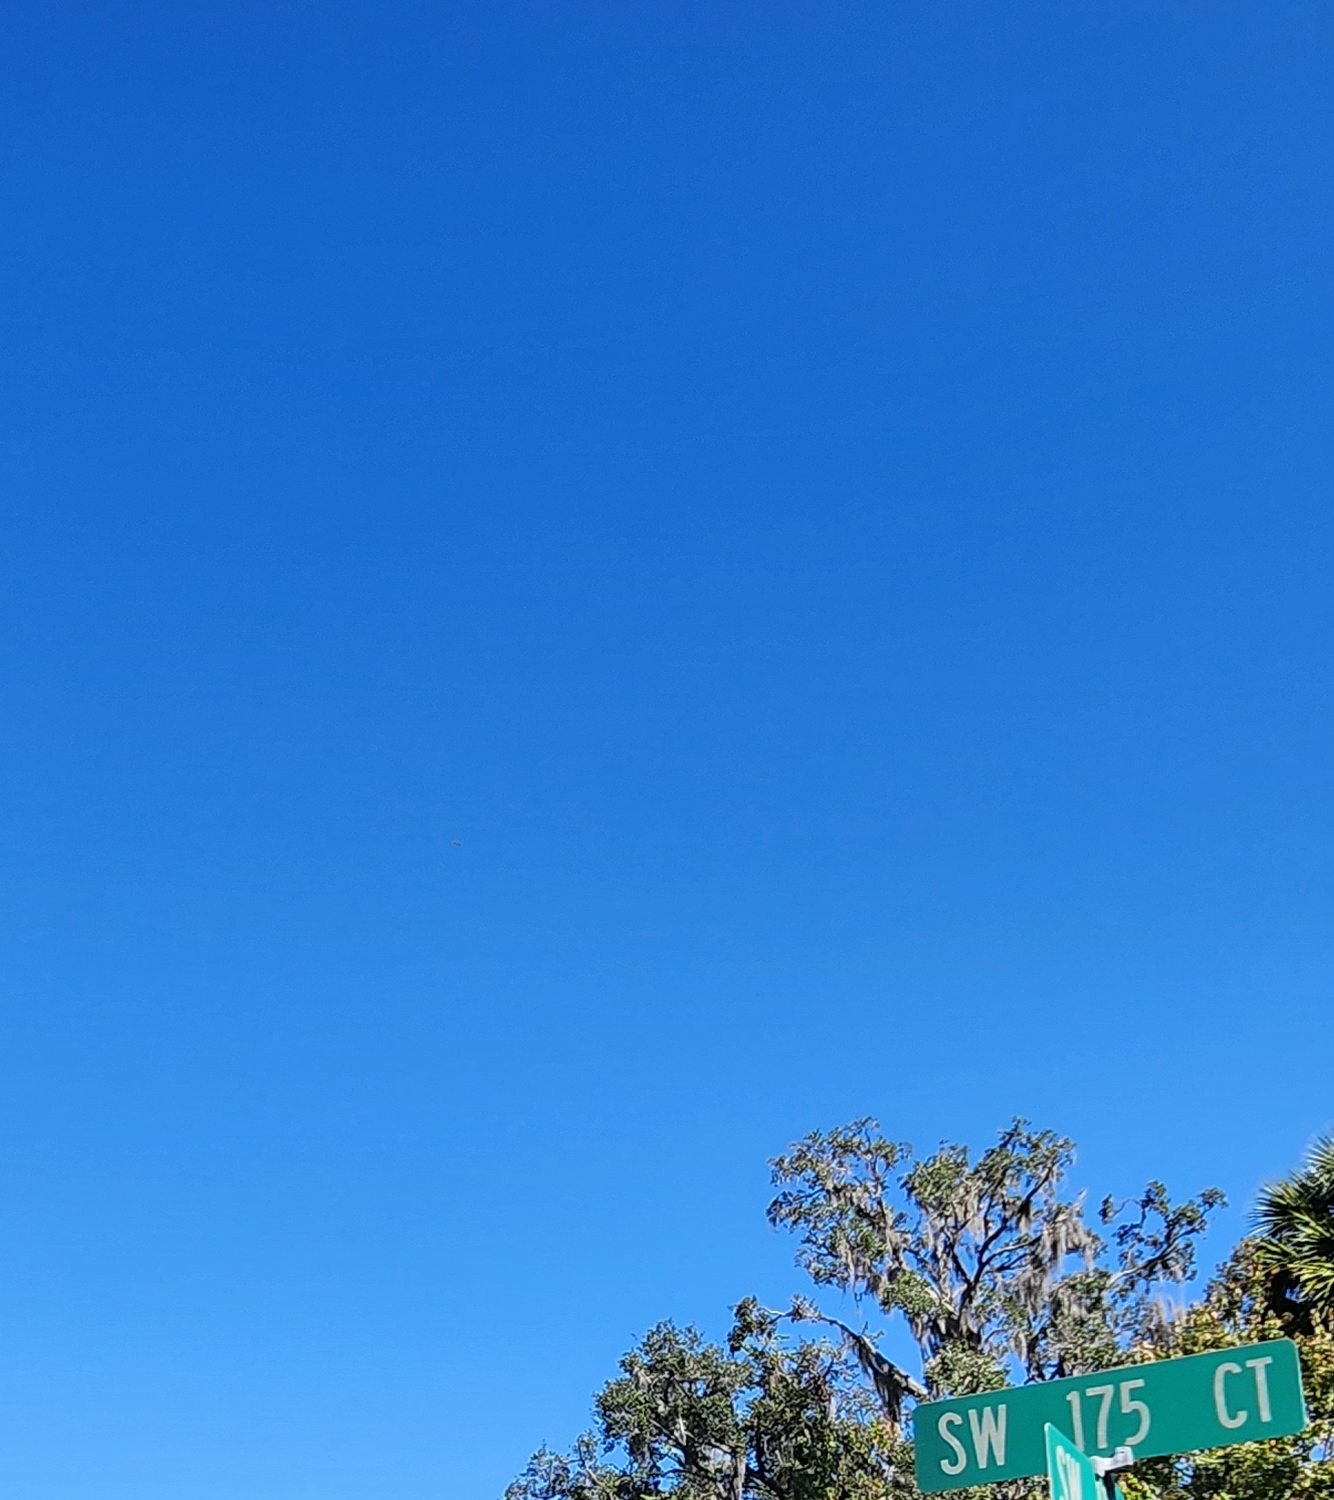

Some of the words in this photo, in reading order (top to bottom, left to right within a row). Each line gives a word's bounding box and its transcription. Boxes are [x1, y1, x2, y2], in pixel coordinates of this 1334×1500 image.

[937, 1403, 1007, 1475] SW
[1066, 1378, 1150, 1452] 175
[1214, 1356, 1273, 1429] CT
